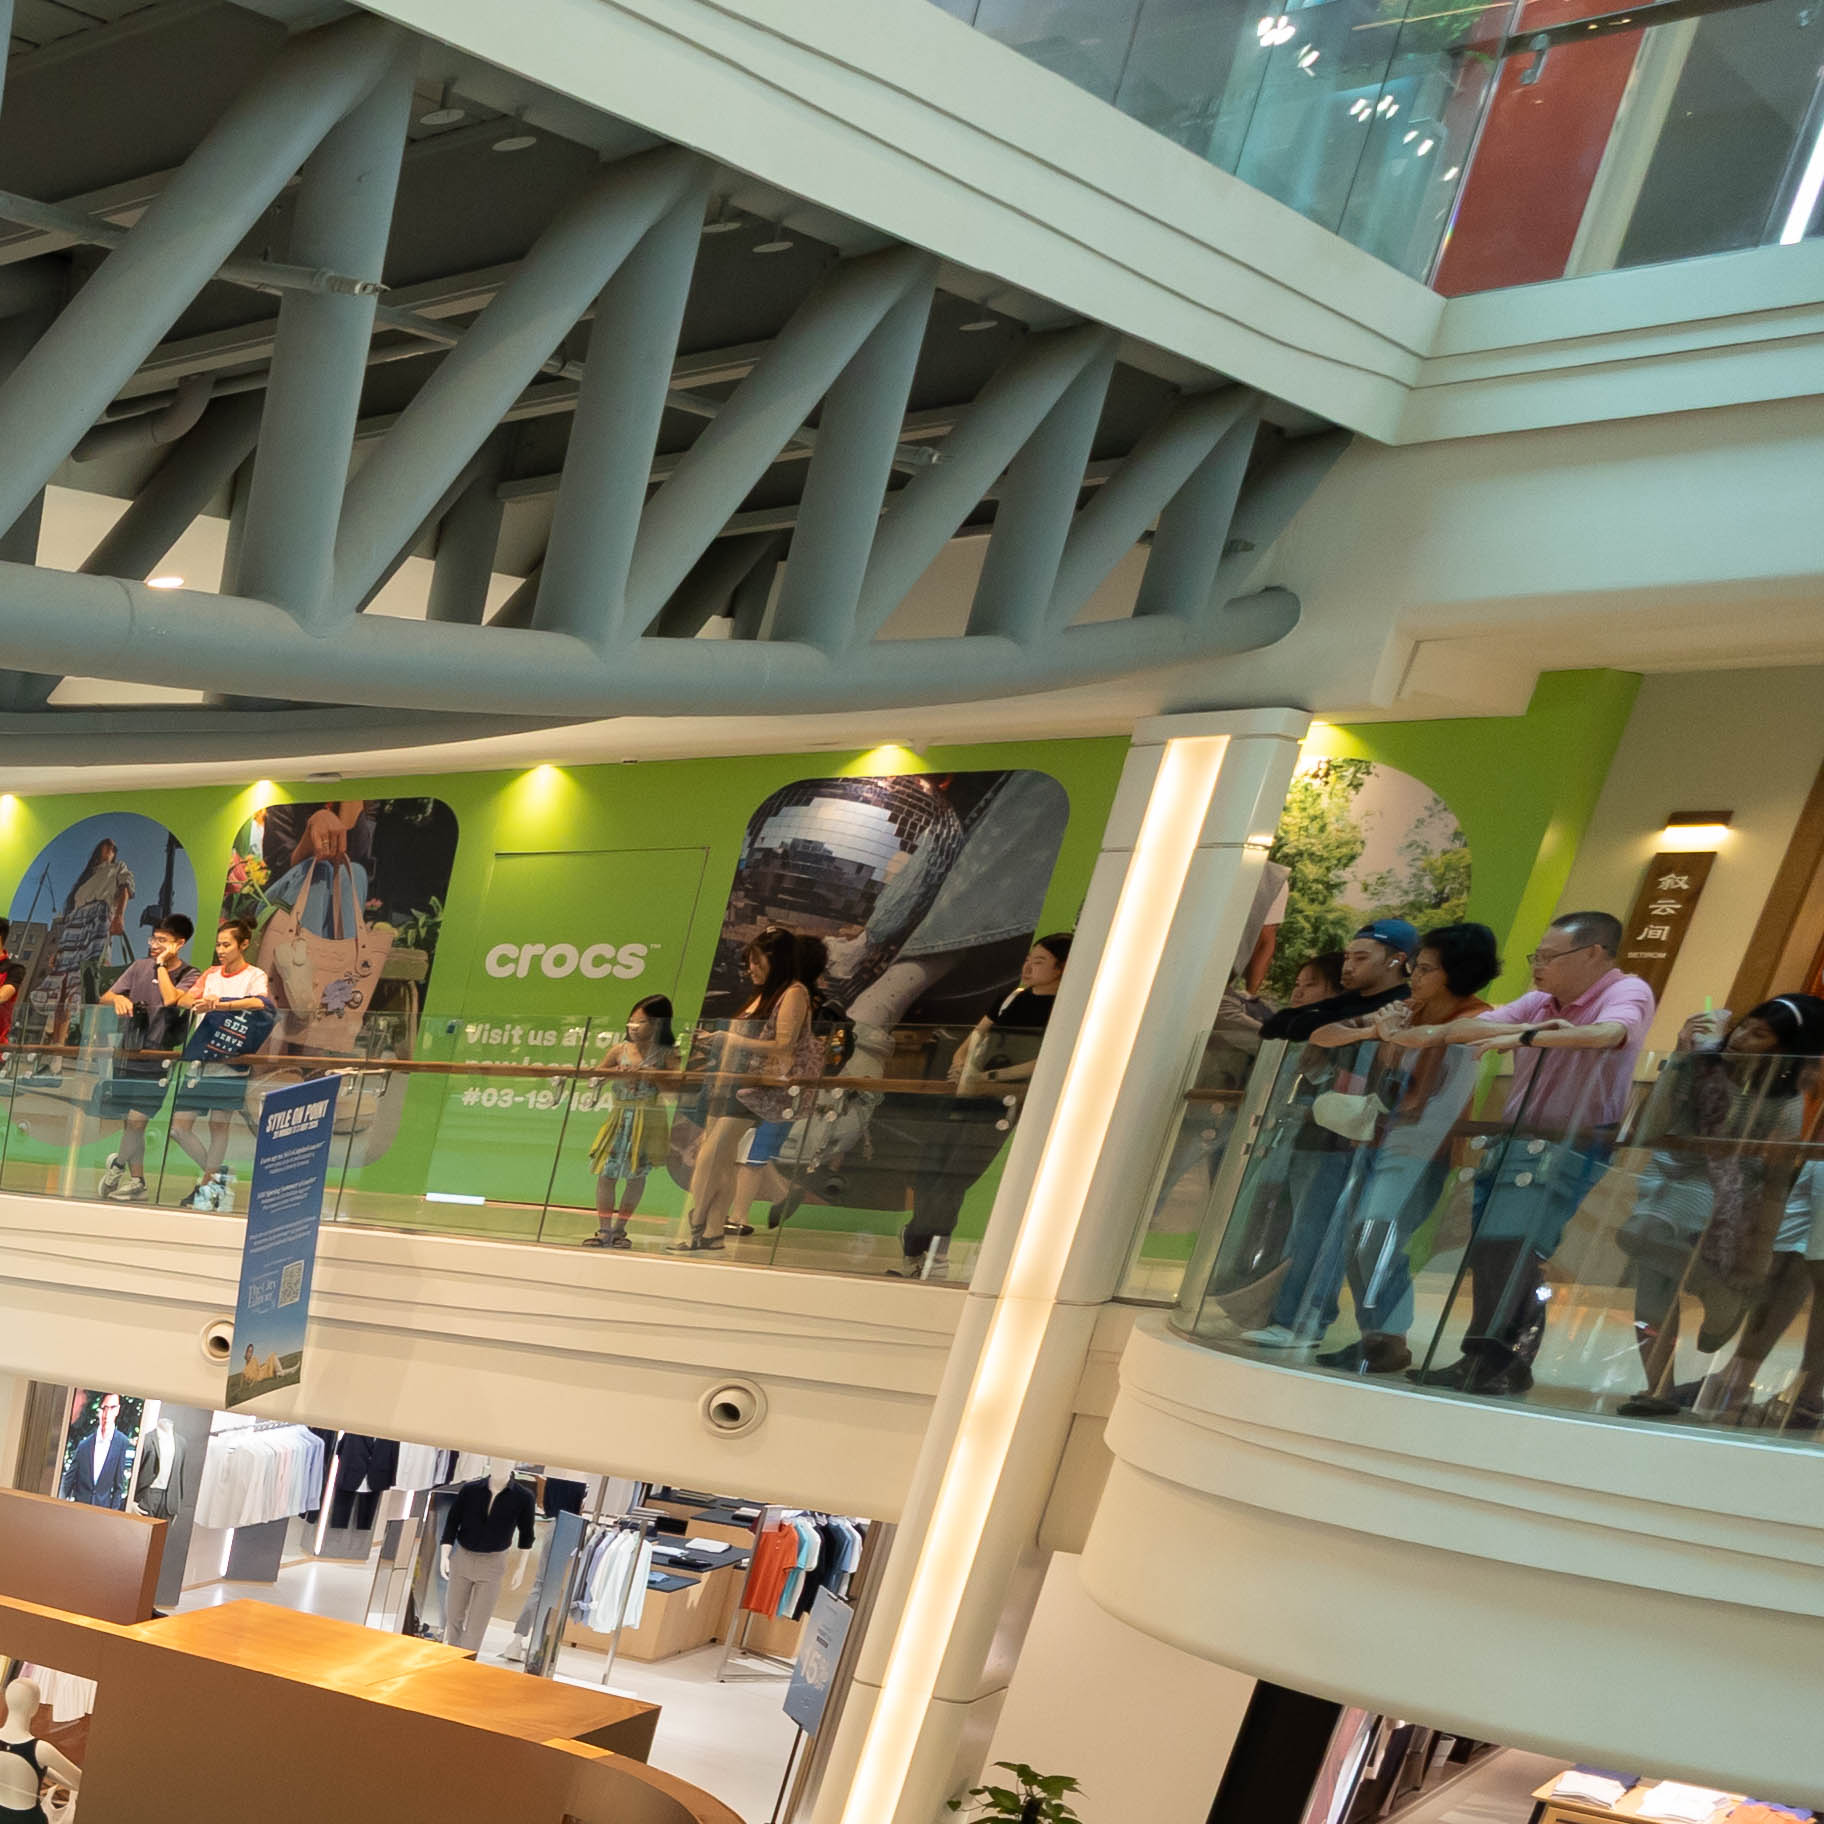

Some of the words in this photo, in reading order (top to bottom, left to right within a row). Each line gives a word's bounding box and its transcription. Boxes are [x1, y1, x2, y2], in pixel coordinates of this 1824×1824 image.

[1636, 873, 1690, 941] 叙云间
[485, 943, 648, 980] crocs
[214, 1031, 244, 1048] SERVE
[224, 1018, 248, 1035] SEE
[466, 1023, 523, 1046] Visit
[527, 1029, 557, 1046] us
[561, 1028, 589, 1049] at
[266, 1108, 292, 1133] STYLE
[291, 1105, 306, 1125] ON
[304, 1099, 330, 1122] POINT
